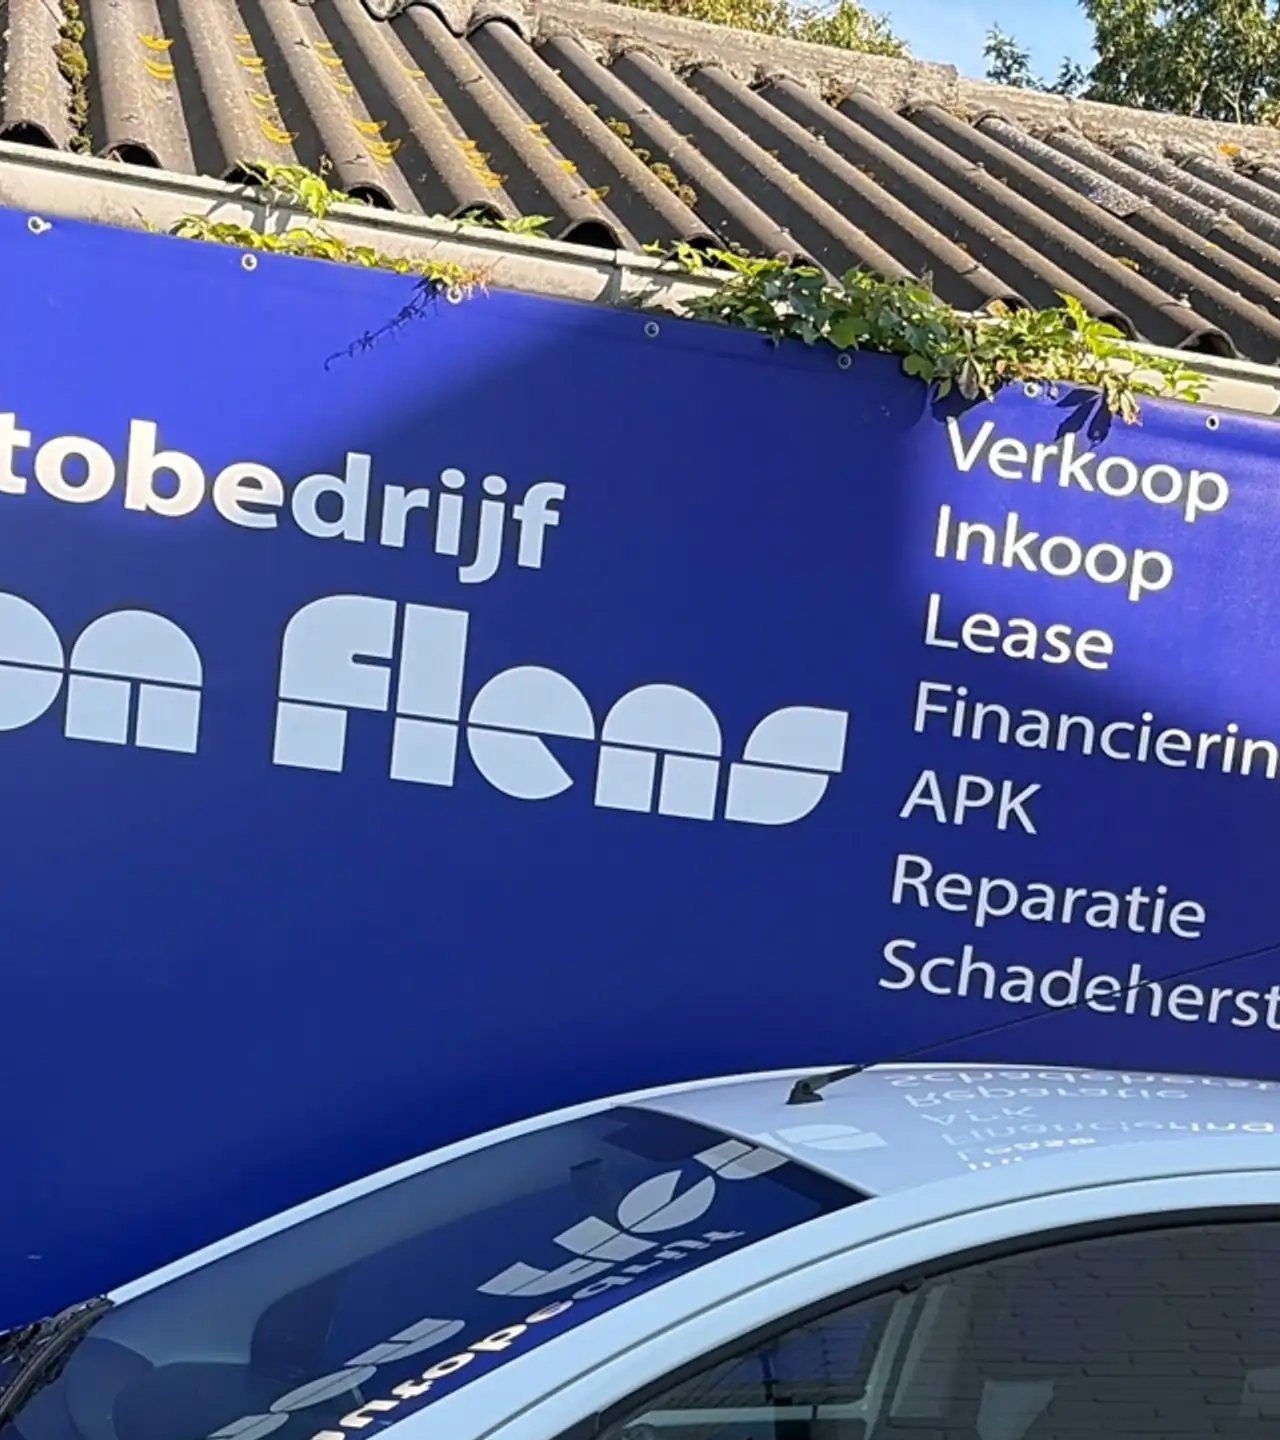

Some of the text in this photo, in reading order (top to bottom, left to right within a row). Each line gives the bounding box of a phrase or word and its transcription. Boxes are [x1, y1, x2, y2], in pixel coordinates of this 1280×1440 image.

[947, 416, 1230, 521] Verkoop
[934, 504, 1174, 601] Inkoop
[924, 593, 1114, 670] Lease
[273, 594, 849, 825] flens
[899, 769, 1041, 835] APK
[892, 854, 1206, 938] Reparatie
